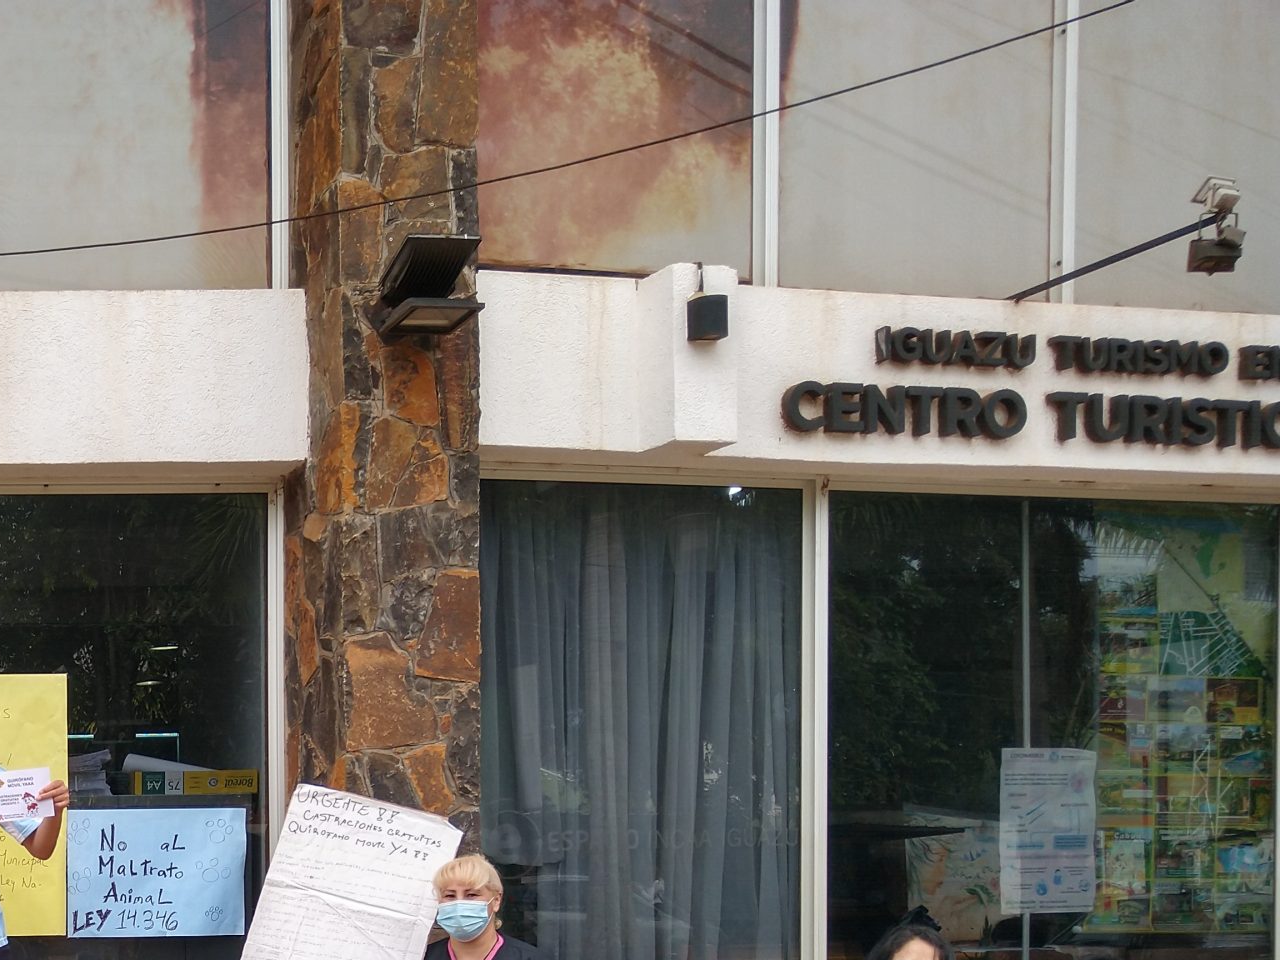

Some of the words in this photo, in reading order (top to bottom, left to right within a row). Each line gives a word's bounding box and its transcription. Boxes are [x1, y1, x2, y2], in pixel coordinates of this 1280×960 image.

[875, 325, 1037, 370] IGUAZU
[1047, 334, 1230, 377] TURISMO
[1238, 344, 1280, 380] E
[781, 380, 1028, 440] CENTRO
[147, 781, 162, 790] A4
[168, 781, 181, 791] 75
[297, 786, 370, 816] URGENTE
[100, 823, 128, 852] No
[389, 841, 408, 855] YA
[72, 909, 112, 935] LEY
[115, 909, 179, 931] 14.346
